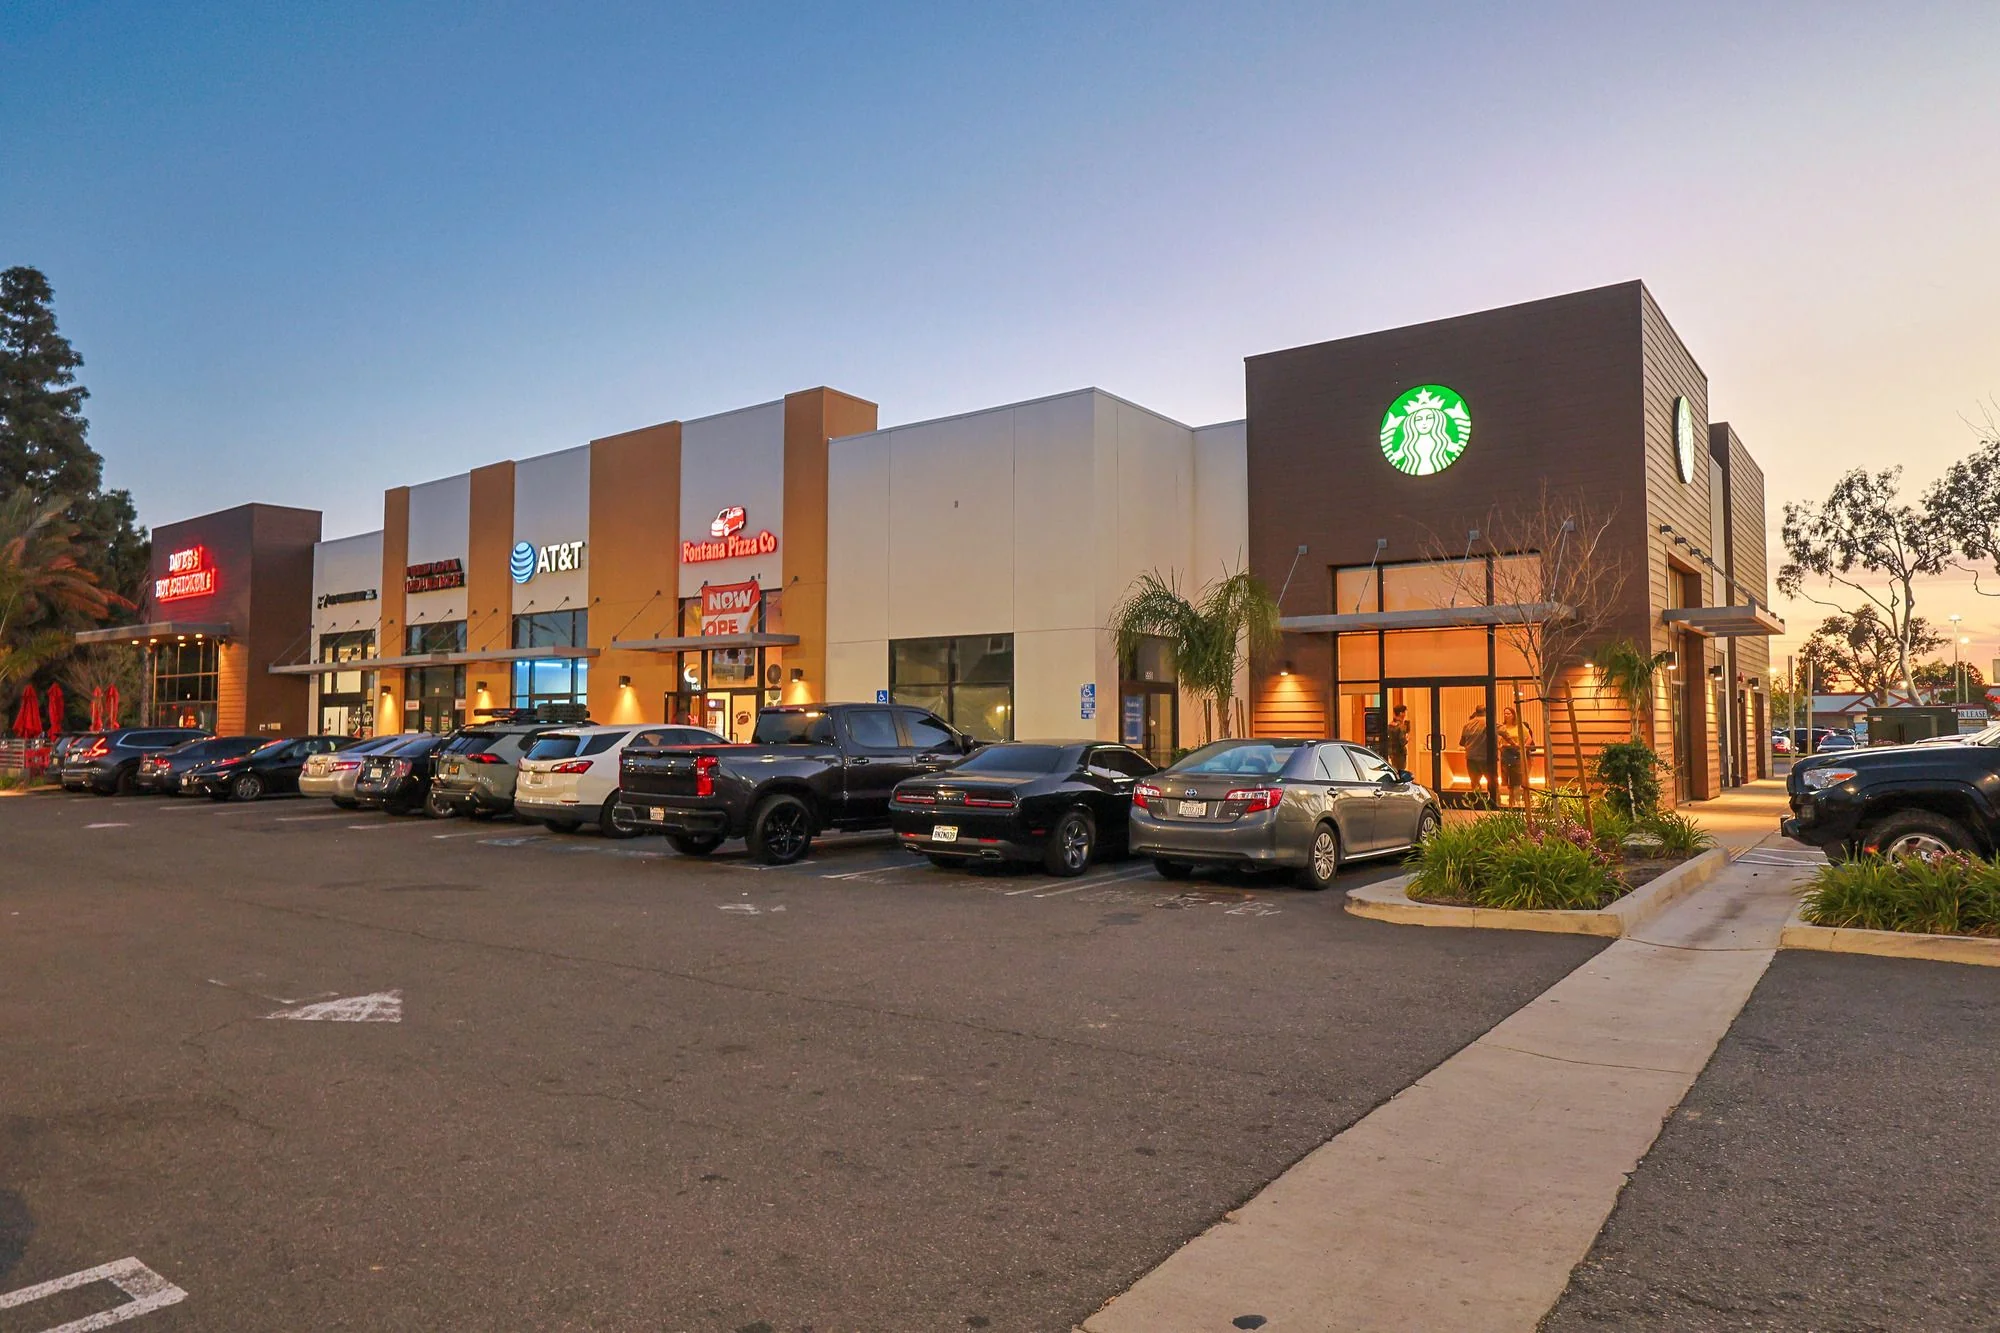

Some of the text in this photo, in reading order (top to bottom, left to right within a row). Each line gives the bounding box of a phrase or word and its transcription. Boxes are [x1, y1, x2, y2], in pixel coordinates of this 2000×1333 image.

[537, 541, 584, 574] AT&T
[683, 531, 776, 562] Fontana Pizza Co
[155, 572, 207, 598] HOT CHICKEN
[709, 589, 752, 610] NOW
[705, 620, 738, 636] OPE
[1966, 710, 1987, 718] LEASE
